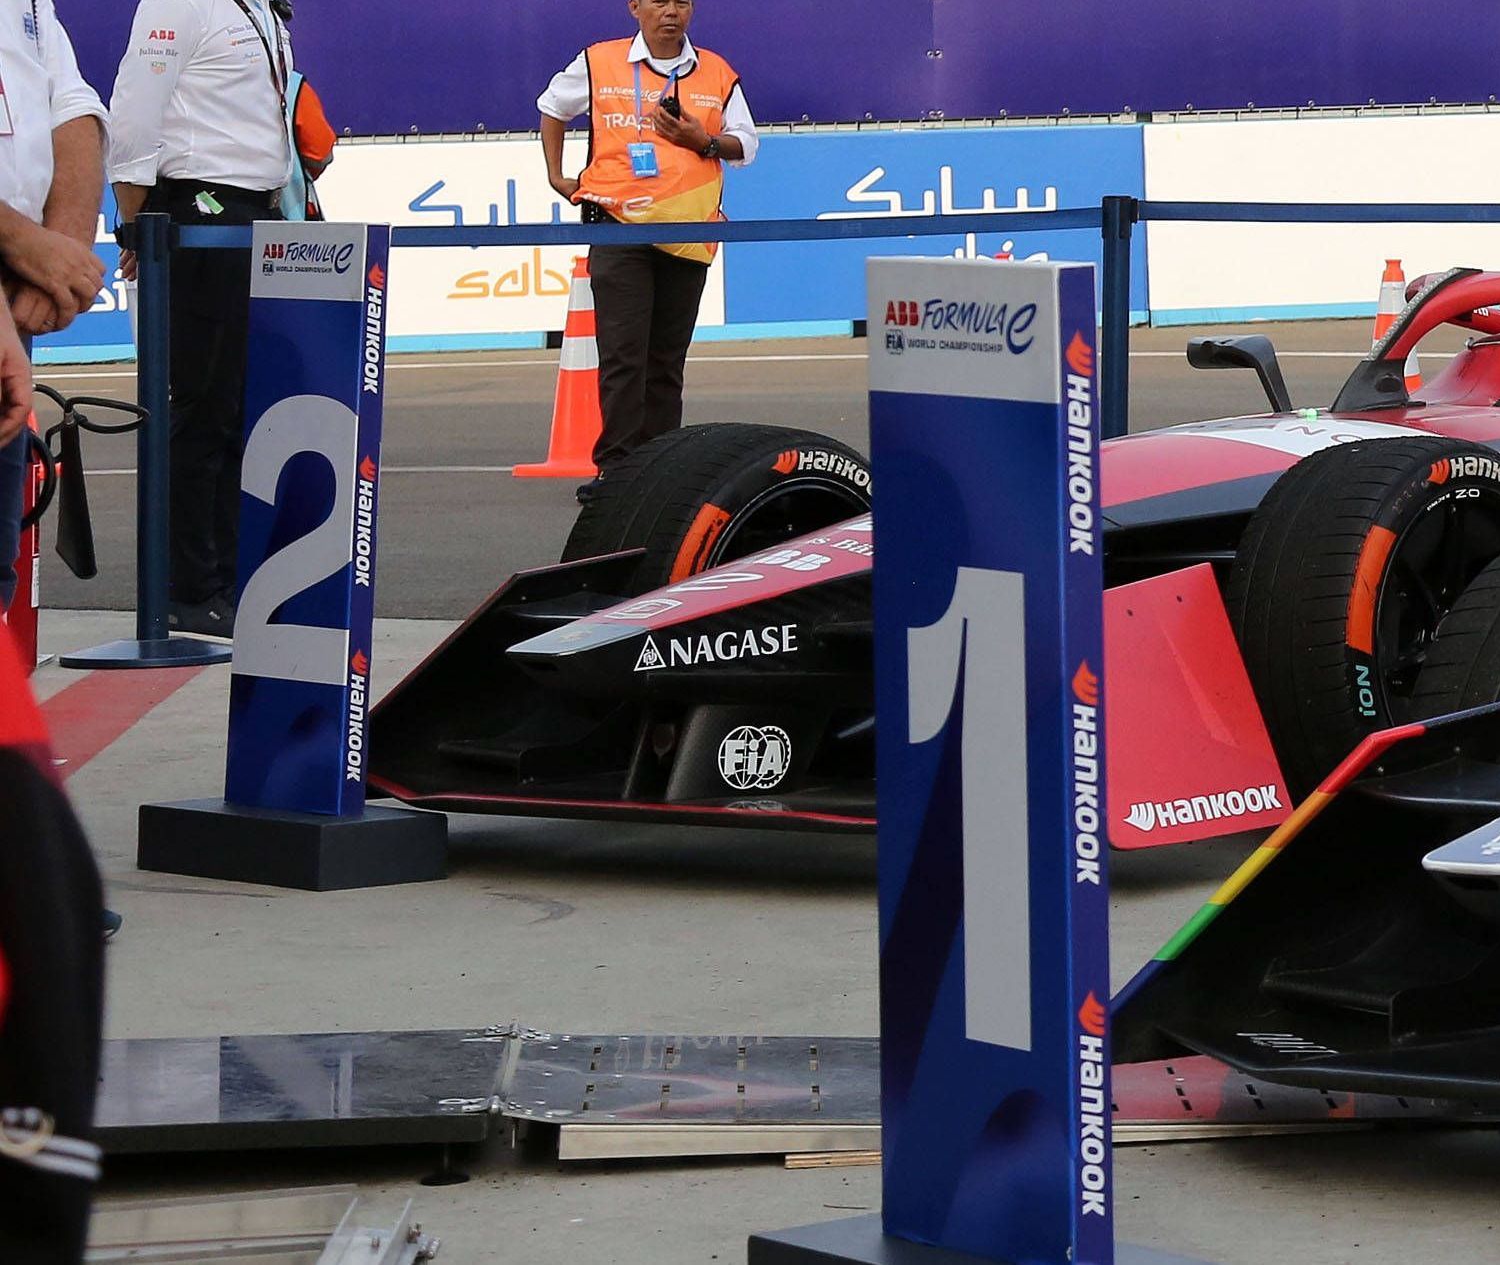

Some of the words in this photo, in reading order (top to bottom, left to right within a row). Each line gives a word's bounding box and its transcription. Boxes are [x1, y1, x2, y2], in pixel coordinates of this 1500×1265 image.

[149, 29, 175, 41] ABB
[262, 243, 284, 259] ABB
[285, 242, 335, 263] FORMULA
[275, 265, 293, 273] WORLD
[885, 300, 919, 326] ABB
[920, 298, 1007, 336] FORMULA
[907, 338, 936, 350] WORLD
[939, 339, 1003, 353] CHAMPIONSHIP
[233, 393, 358, 686] 2
[669, 623, 798, 667] NAGASE
[907, 565, 1032, 1052] 1
[1154, 784, 1283, 828] Hankook
